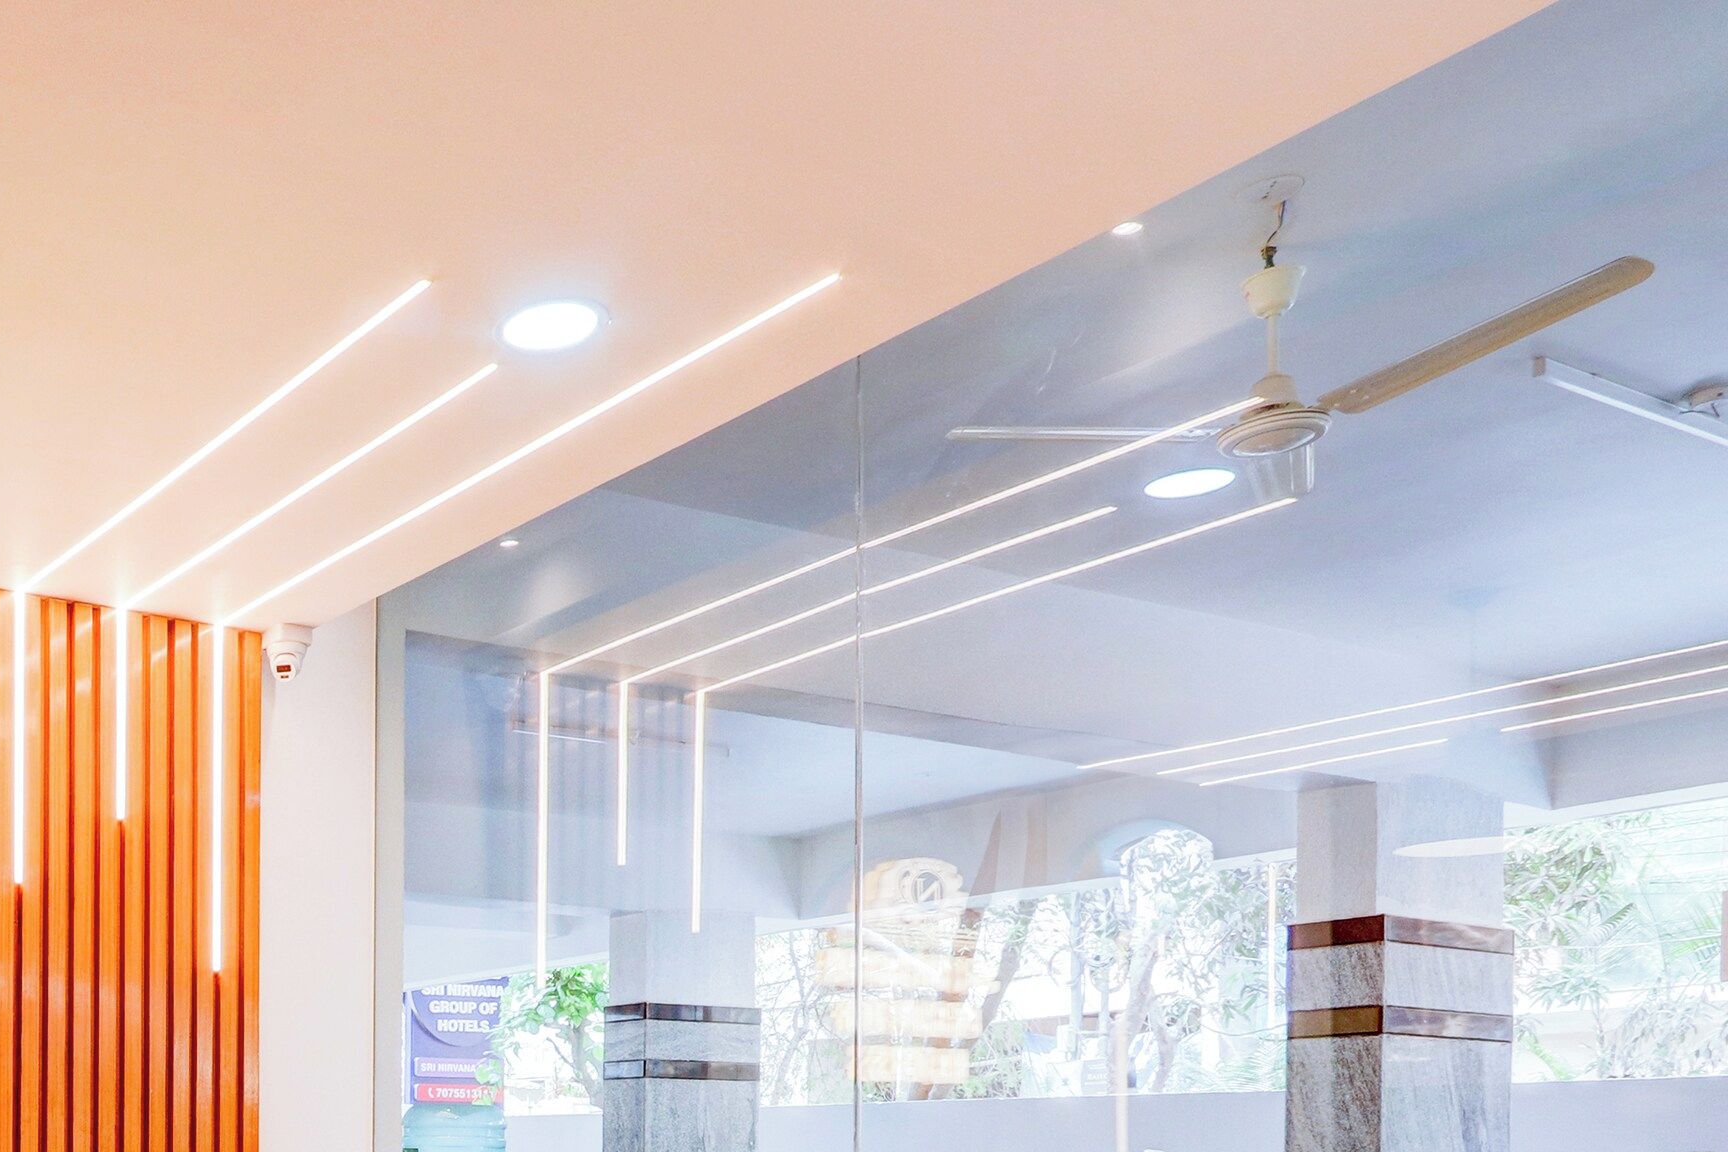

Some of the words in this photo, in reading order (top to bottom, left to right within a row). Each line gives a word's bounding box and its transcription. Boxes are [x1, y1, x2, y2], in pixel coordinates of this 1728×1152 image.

[446, 984, 504, 998] NIRVANA
[429, 1000, 477, 1014] GROUP
[478, 1001, 498, 1015] OF
[436, 1019, 490, 1033] HOTELS
[420, 1062, 436, 1072] SRI
[438, 1062, 476, 1072] NIRVANA
